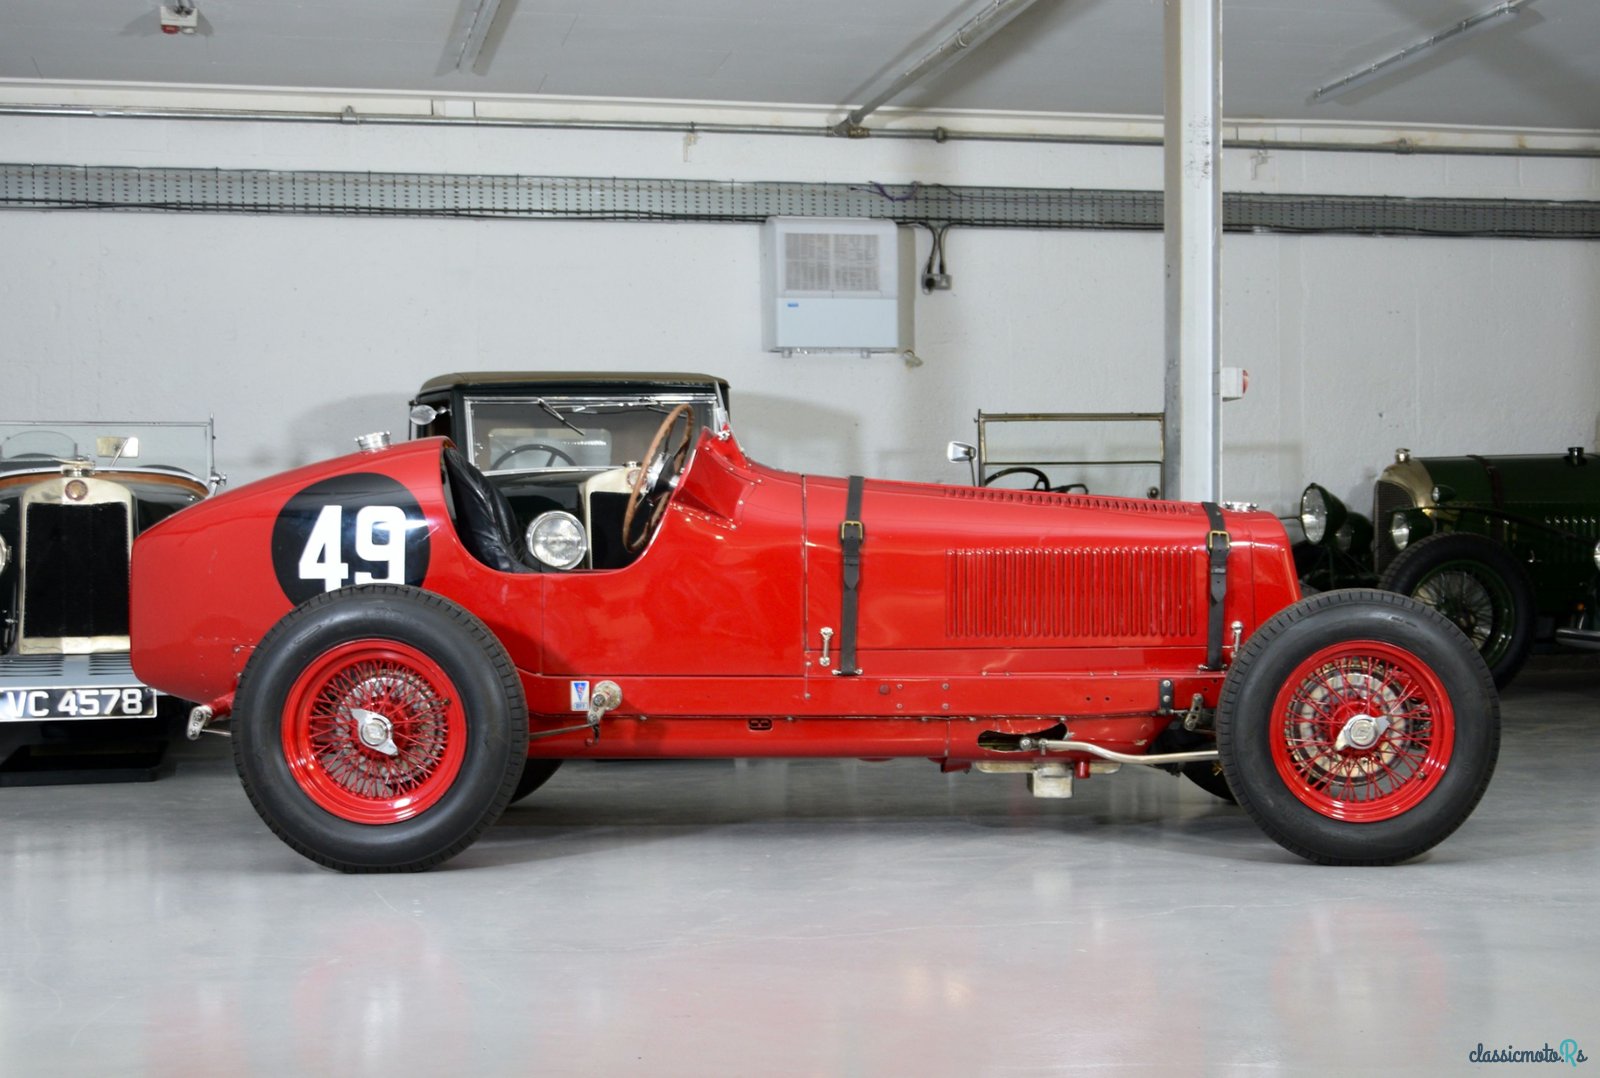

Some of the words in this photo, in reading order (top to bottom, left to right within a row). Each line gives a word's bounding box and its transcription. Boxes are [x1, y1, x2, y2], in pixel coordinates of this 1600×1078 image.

[299, 505, 407, 592] 49
[7, 690, 50, 718] VC
[57, 688, 143, 716] 4578
